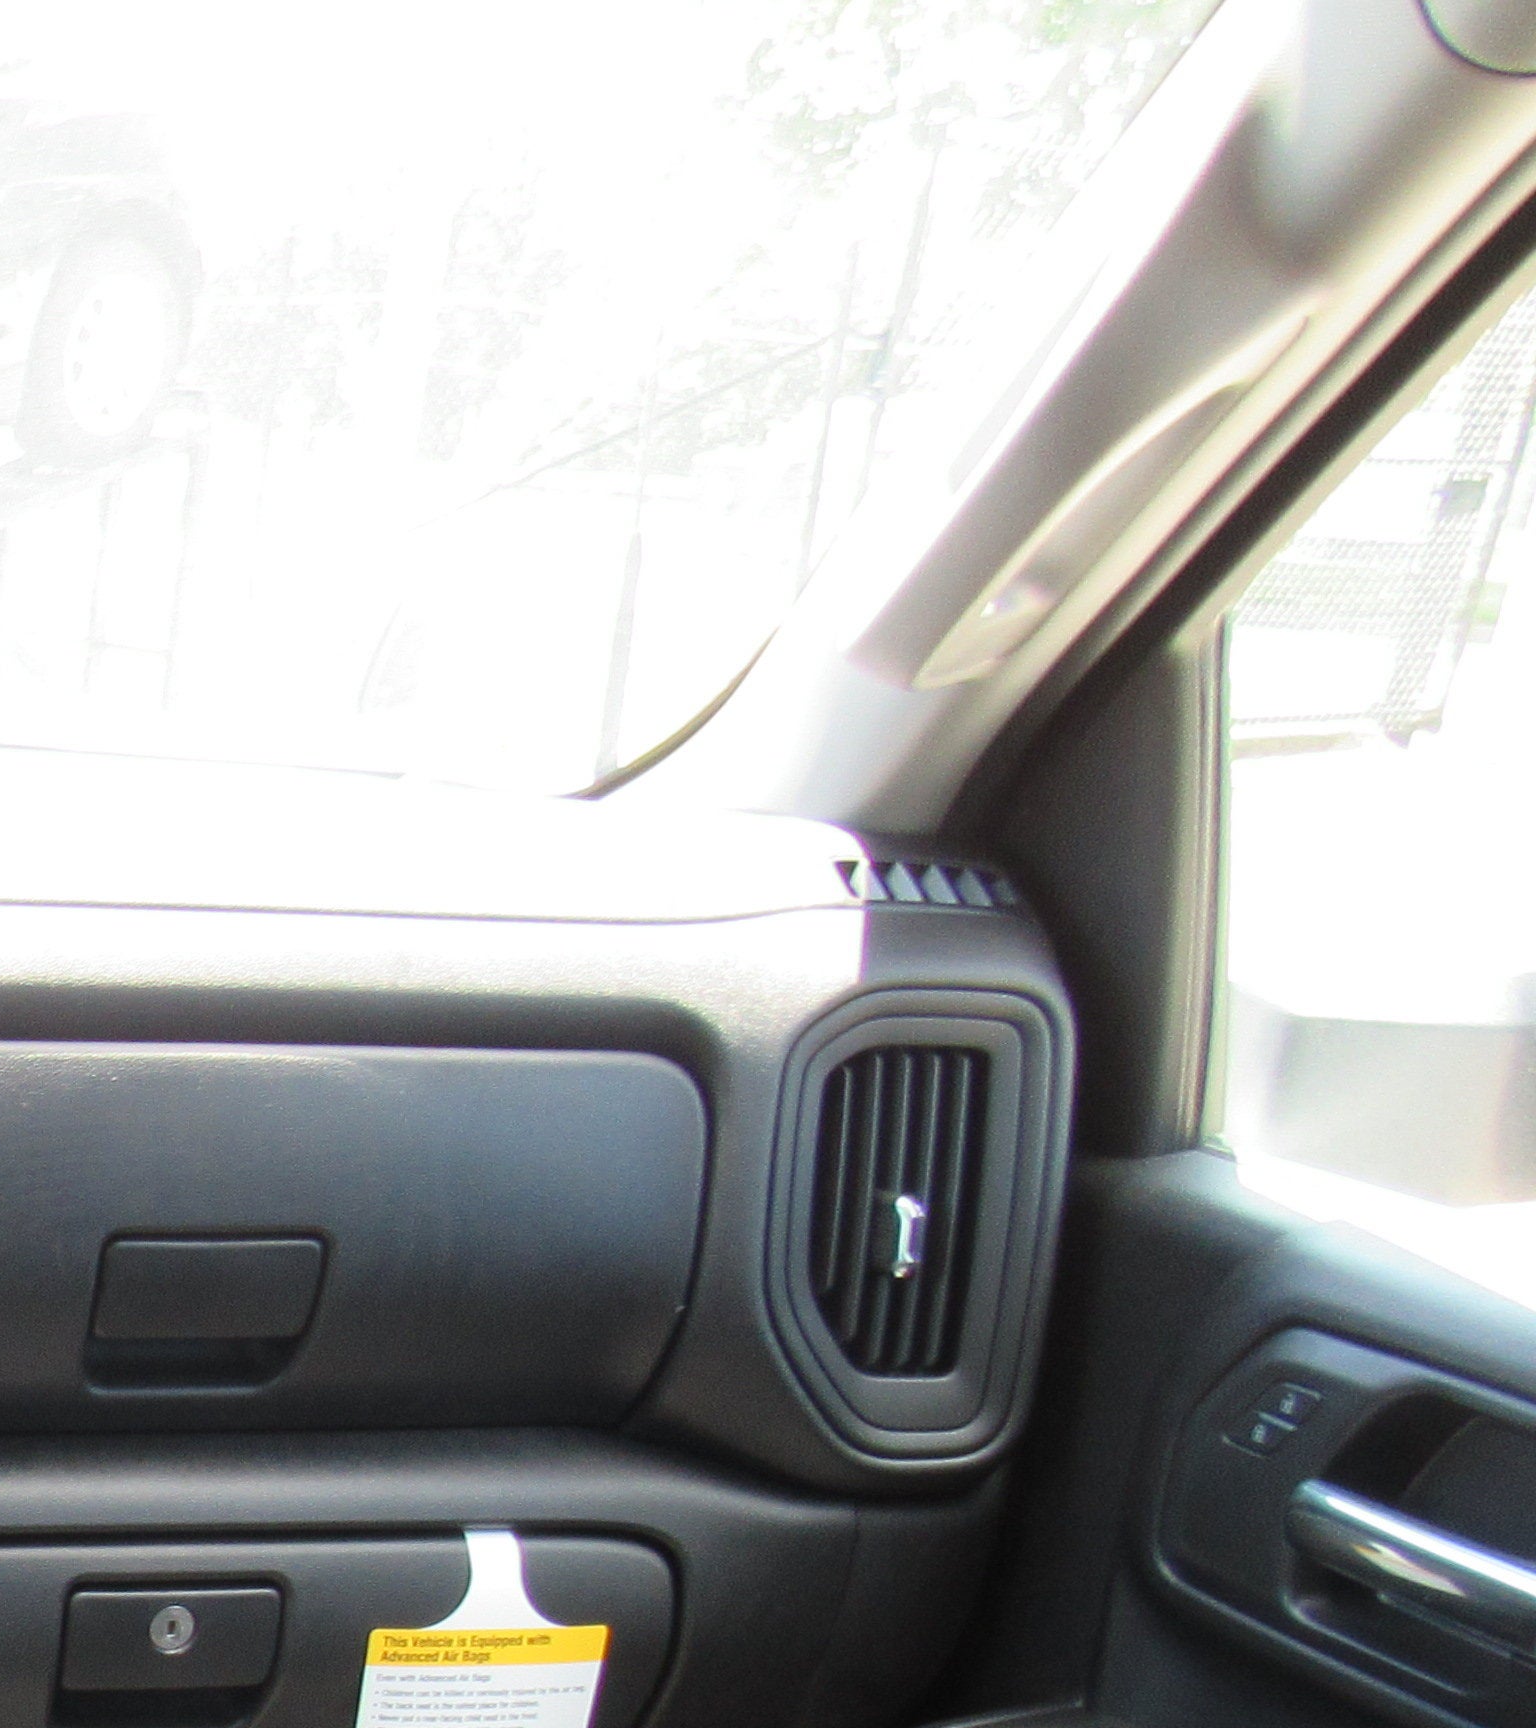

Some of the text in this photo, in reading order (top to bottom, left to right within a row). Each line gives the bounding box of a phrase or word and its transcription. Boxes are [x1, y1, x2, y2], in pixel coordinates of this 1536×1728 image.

[384, 1634, 551, 1649] This Vehicle is Equipped with
[380, 1650, 491, 1664] Advanced Air Bags
